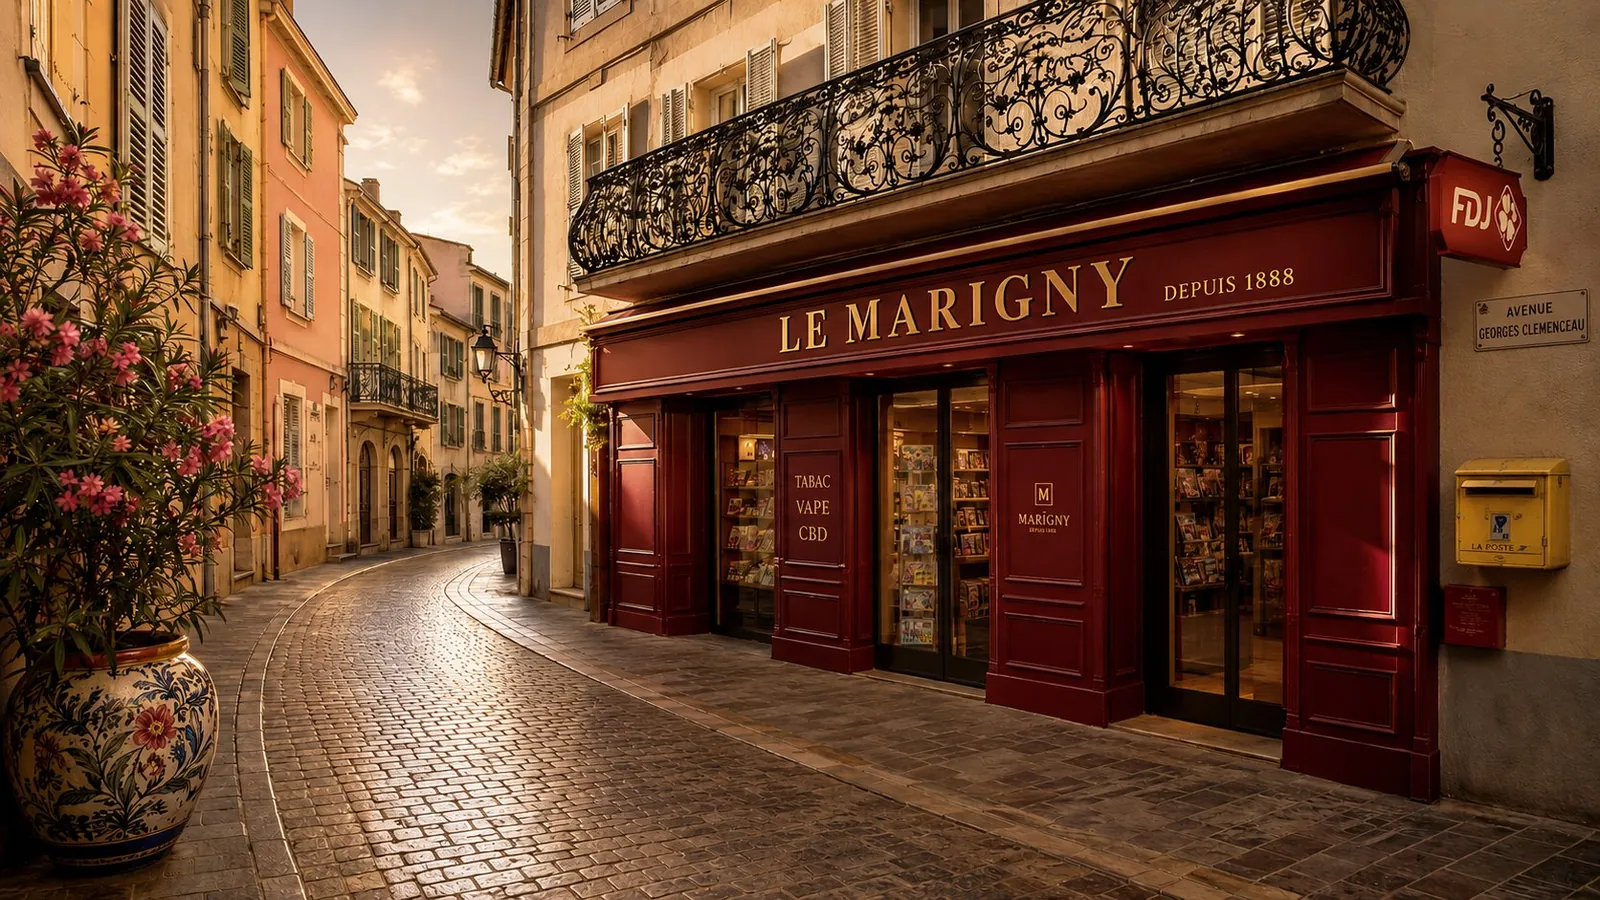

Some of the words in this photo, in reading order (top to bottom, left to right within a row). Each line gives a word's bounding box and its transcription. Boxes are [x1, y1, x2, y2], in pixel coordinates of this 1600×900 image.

[1451, 186, 1492, 230] FDJ
[779, 309, 827, 354] LE
[845, 256, 1134, 344] MARIGNY
[1164, 275, 1236, 301] DEPUIS
[1245, 267, 1294, 291] 1888
[1506, 302, 1553, 318] AVENUE
[1479, 325, 1520, 340] GEORGES
[1522, 318, 1585, 336] CLEMENCEAU
[795, 474, 831, 489] TABAC
[1038, 487, 1049, 501] M
[796, 500, 830, 515] VAPE
[799, 525, 828, 541] CBD
[1485, 543, 1514, 551] POSTE
